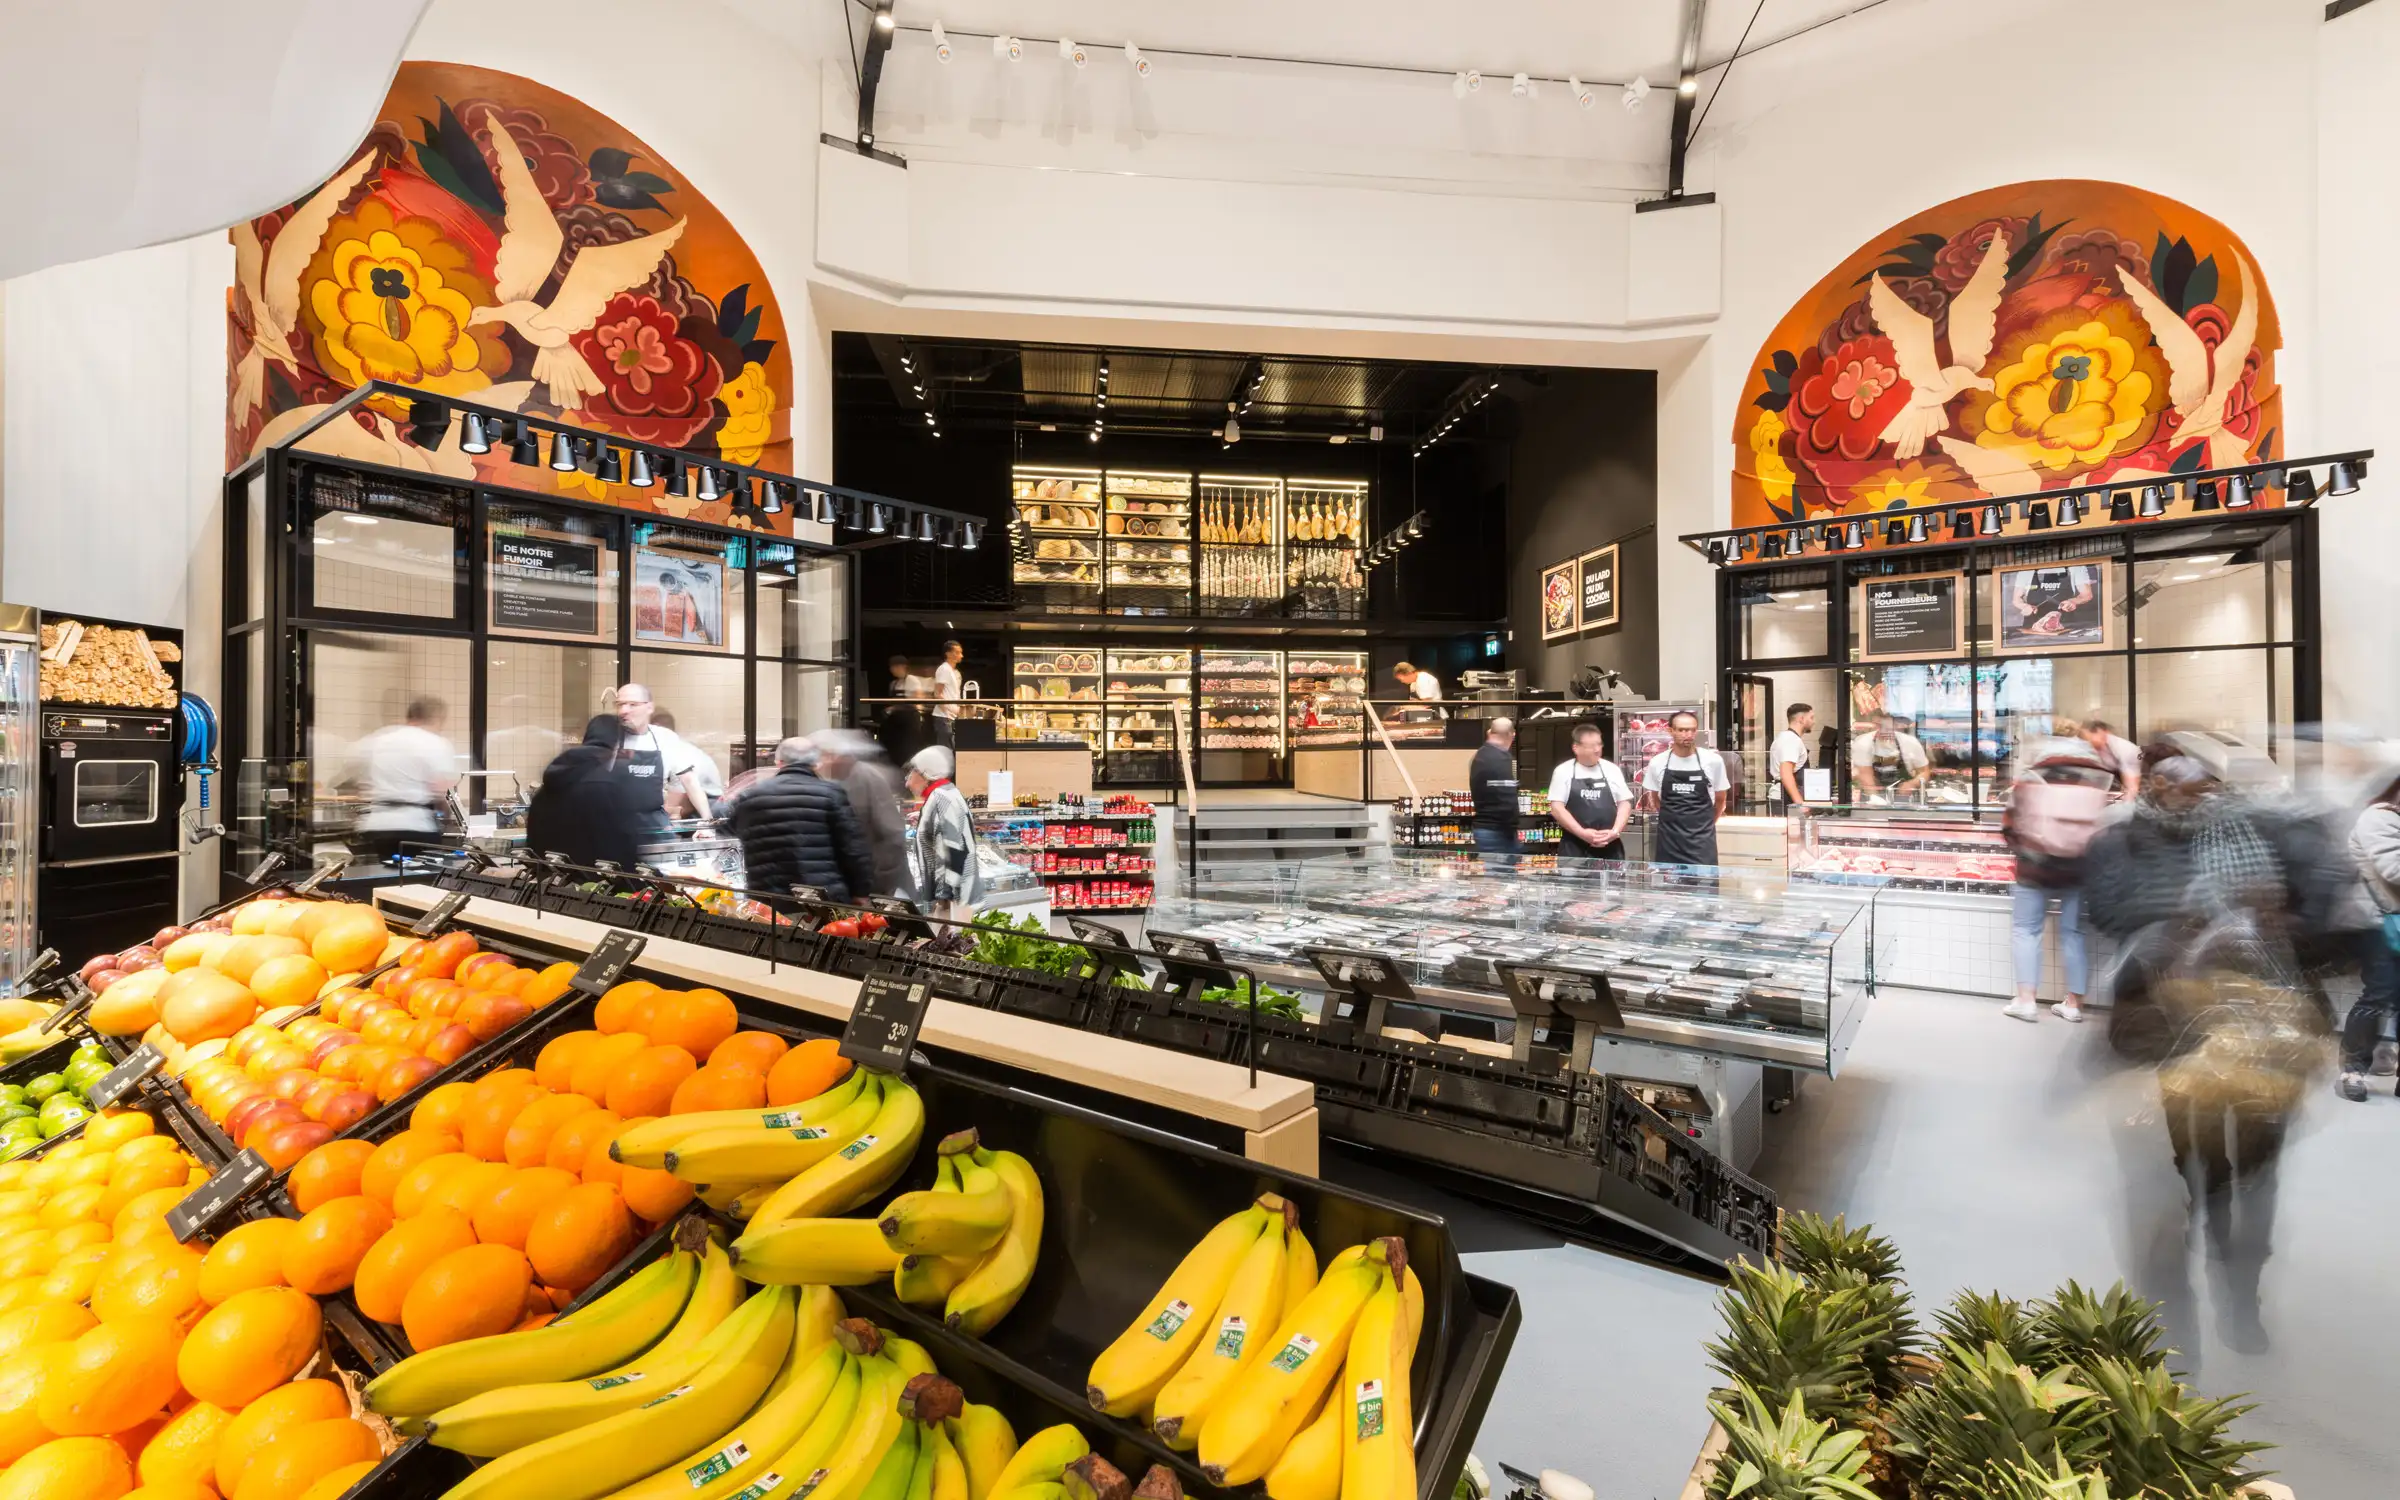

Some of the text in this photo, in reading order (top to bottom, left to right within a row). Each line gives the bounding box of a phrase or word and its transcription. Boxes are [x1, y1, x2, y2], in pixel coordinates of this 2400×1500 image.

[504, 544, 553, 558] DE NOTRE
[504, 555, 543, 567] FUMOIR
[1586, 569, 1610, 584] DU LARD
[1586, 582, 1603, 595] OU DU
[1586, 590, 1610, 605] COCHON
[1875, 596, 1938, 606] FOURNISSEURS
[1229, 1332, 1242, 1341] bio
[1292, 1348, 1305, 1360] bio
[1367, 1402, 1381, 1411] bio
[715, 1459, 726, 1474] bio
